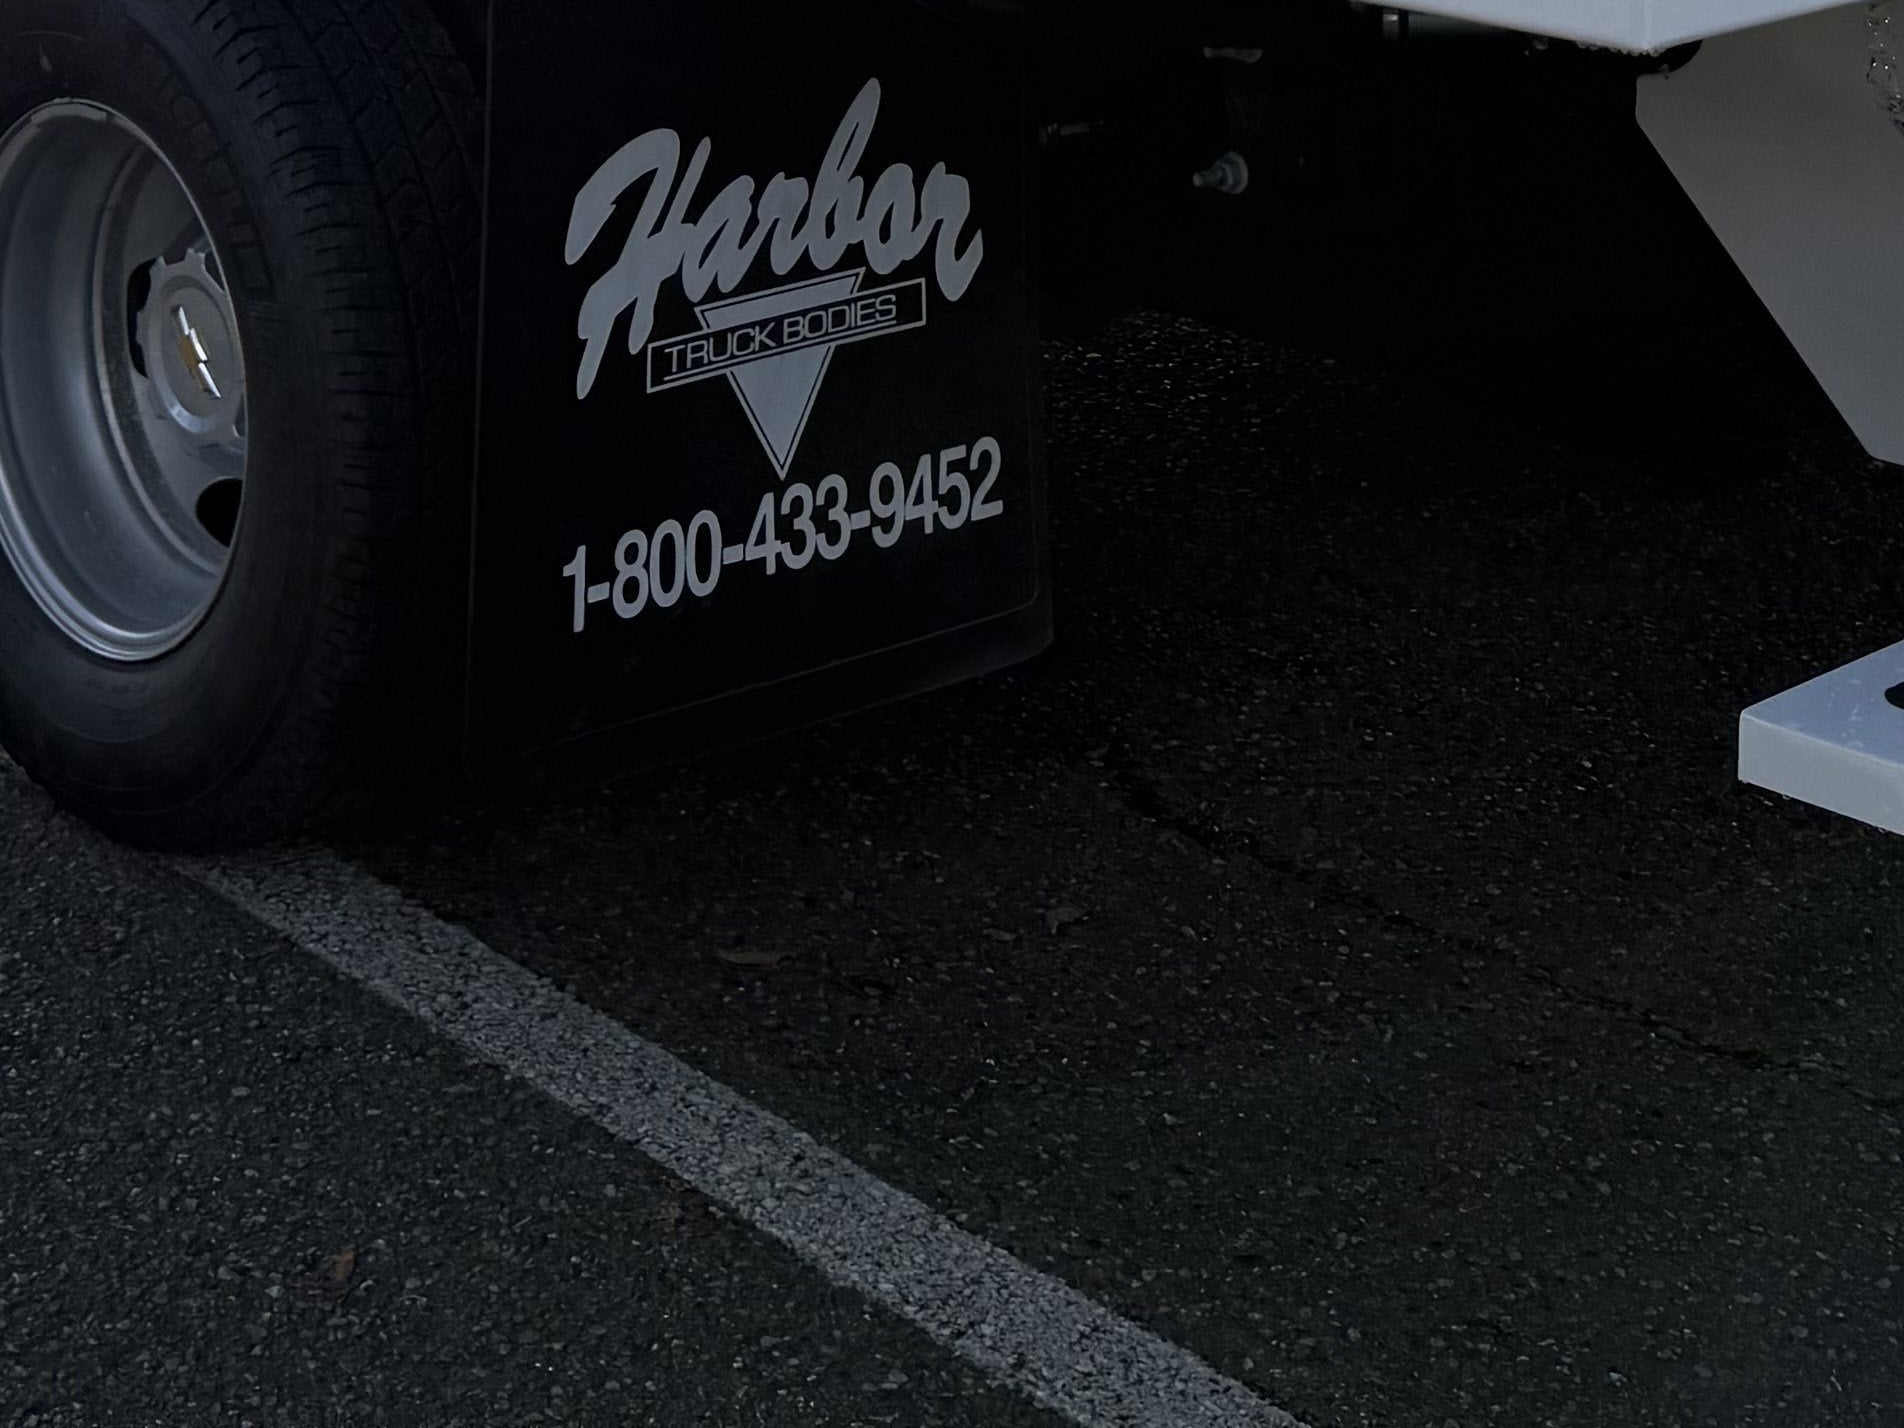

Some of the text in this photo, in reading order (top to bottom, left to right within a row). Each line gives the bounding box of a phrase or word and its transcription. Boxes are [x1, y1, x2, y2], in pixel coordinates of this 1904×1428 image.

[564, 77, 984, 400] Harbor
[664, 294, 897, 373] TRUCK BODIES
[562, 436, 1003, 633] 1-800-433-9452
